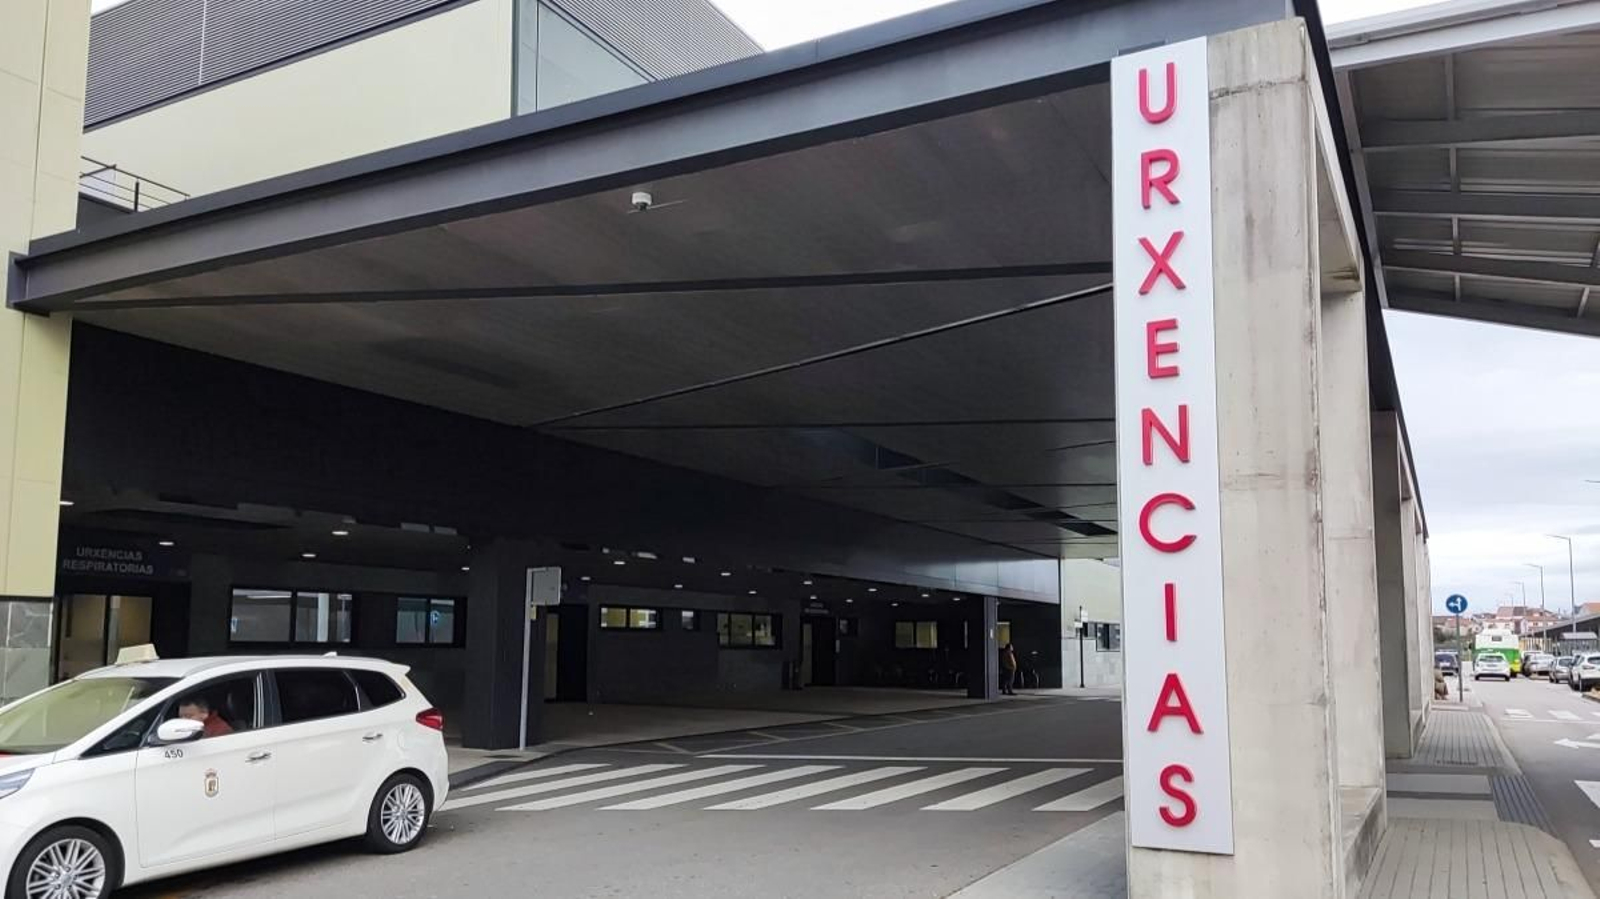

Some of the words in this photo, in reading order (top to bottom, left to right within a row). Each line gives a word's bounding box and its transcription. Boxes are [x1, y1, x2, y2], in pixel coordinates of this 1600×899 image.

[1138, 64, 1202, 827] URXENCIAS
[76, 546, 143, 560] URXENCIAS
[62, 559, 154, 574] RESPIRATORIAS
[164, 748, 183, 759] 450
